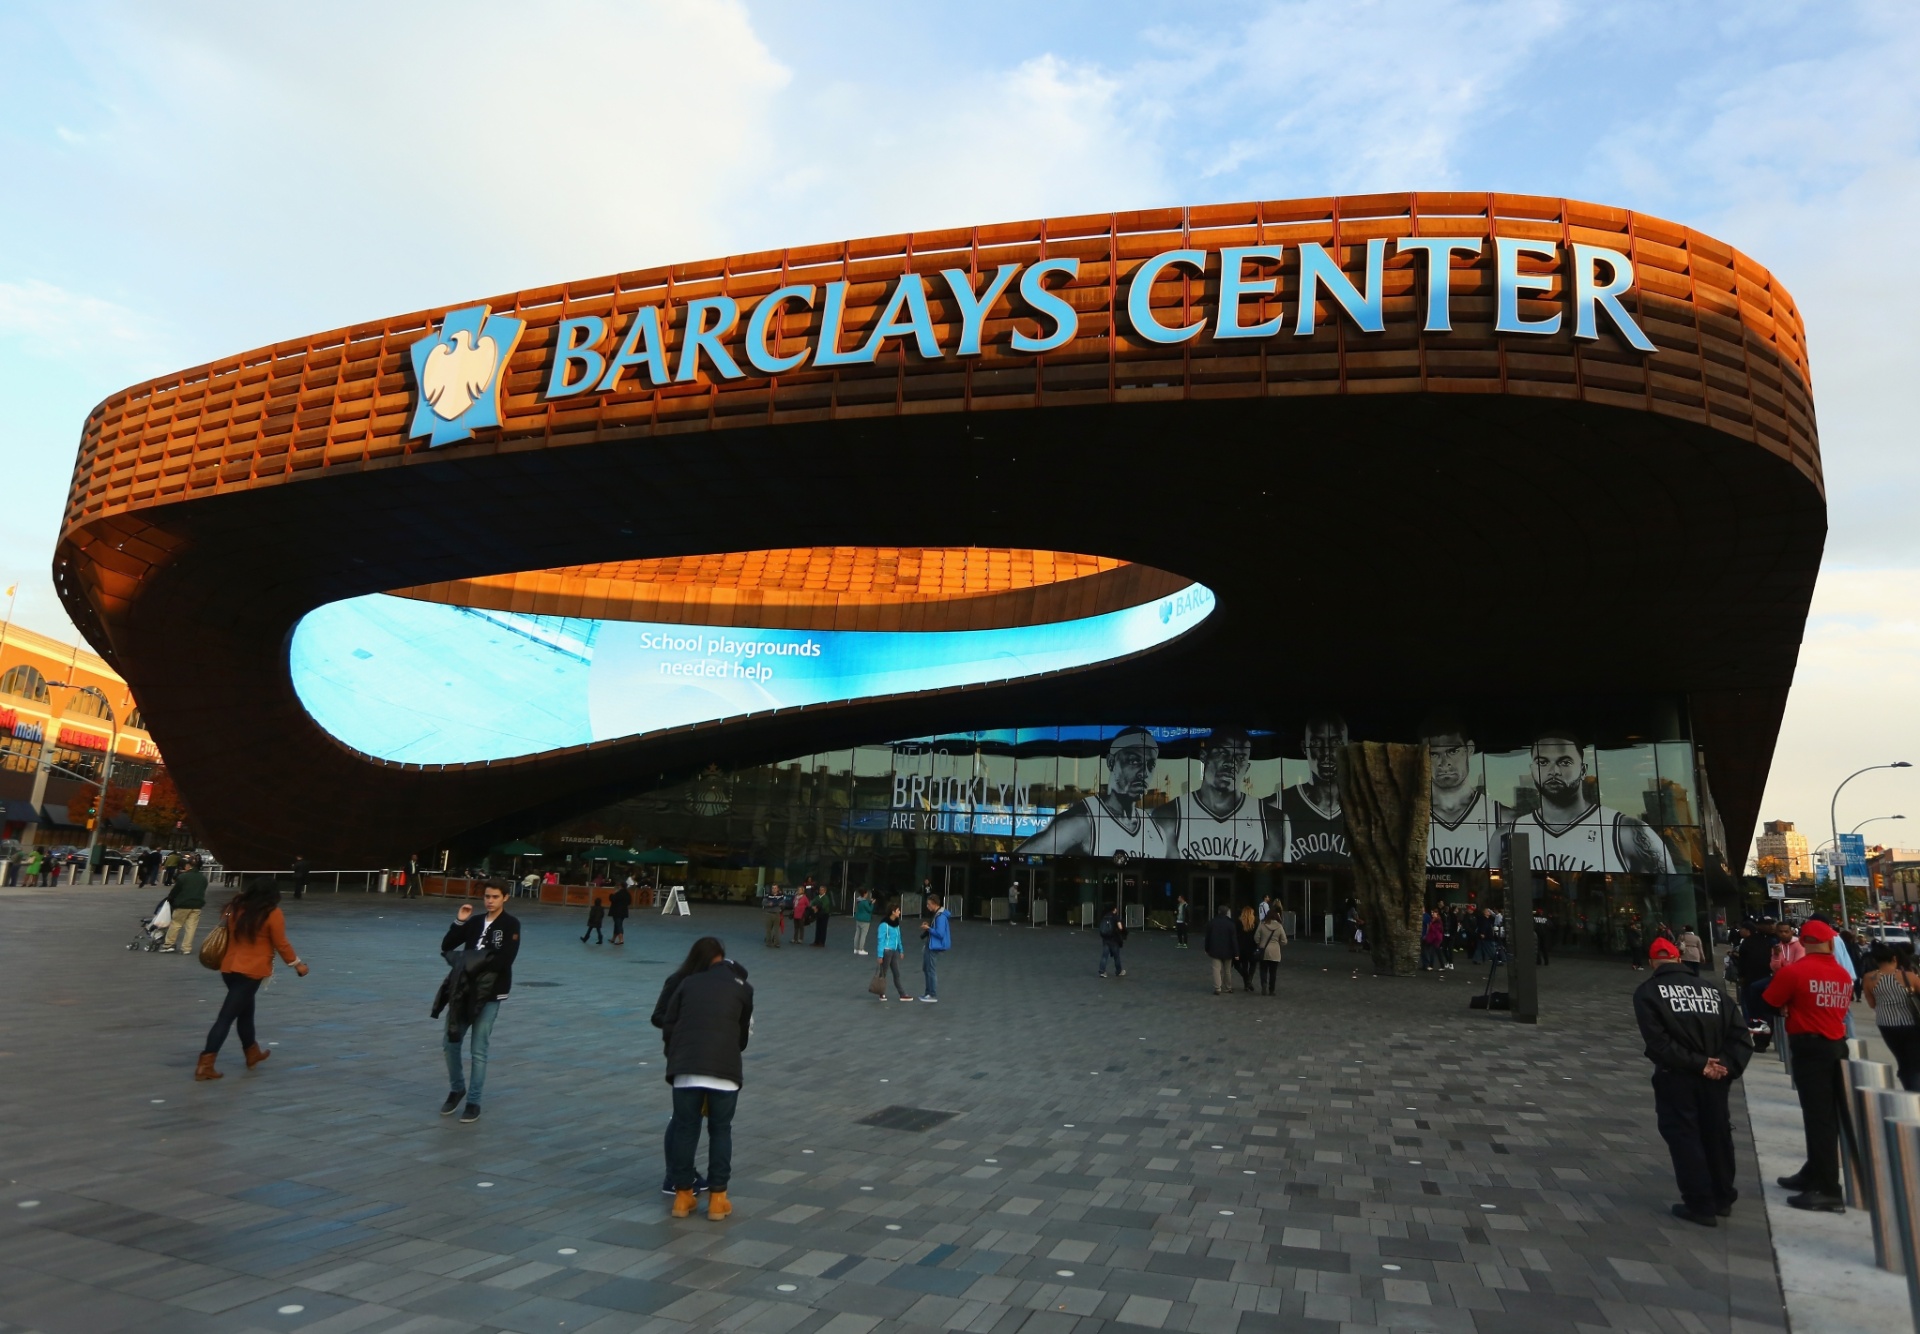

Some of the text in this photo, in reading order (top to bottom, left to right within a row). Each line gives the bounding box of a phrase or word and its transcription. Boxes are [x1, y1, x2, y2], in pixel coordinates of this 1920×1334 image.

[545, 236, 1660, 399] BARCLAYS CENTER
[640, 632, 821, 659] School playgrounds
[660, 660, 773, 683] needed help
[892, 772, 1031, 813] BROOKLYN
[891, 813, 915, 830] ARE
[922, 813, 947, 831] YOU
[981, 814, 1028, 829] Barclays
[561, 836, 624, 846] STARBUCKS COFFEE
[1181, 836, 1260, 862] BROOKLYN
[1290, 832, 1352, 862] BROOKL
[1658, 984, 1721, 1001] BARCLAYS
[1670, 998, 1719, 1015] CENTER
